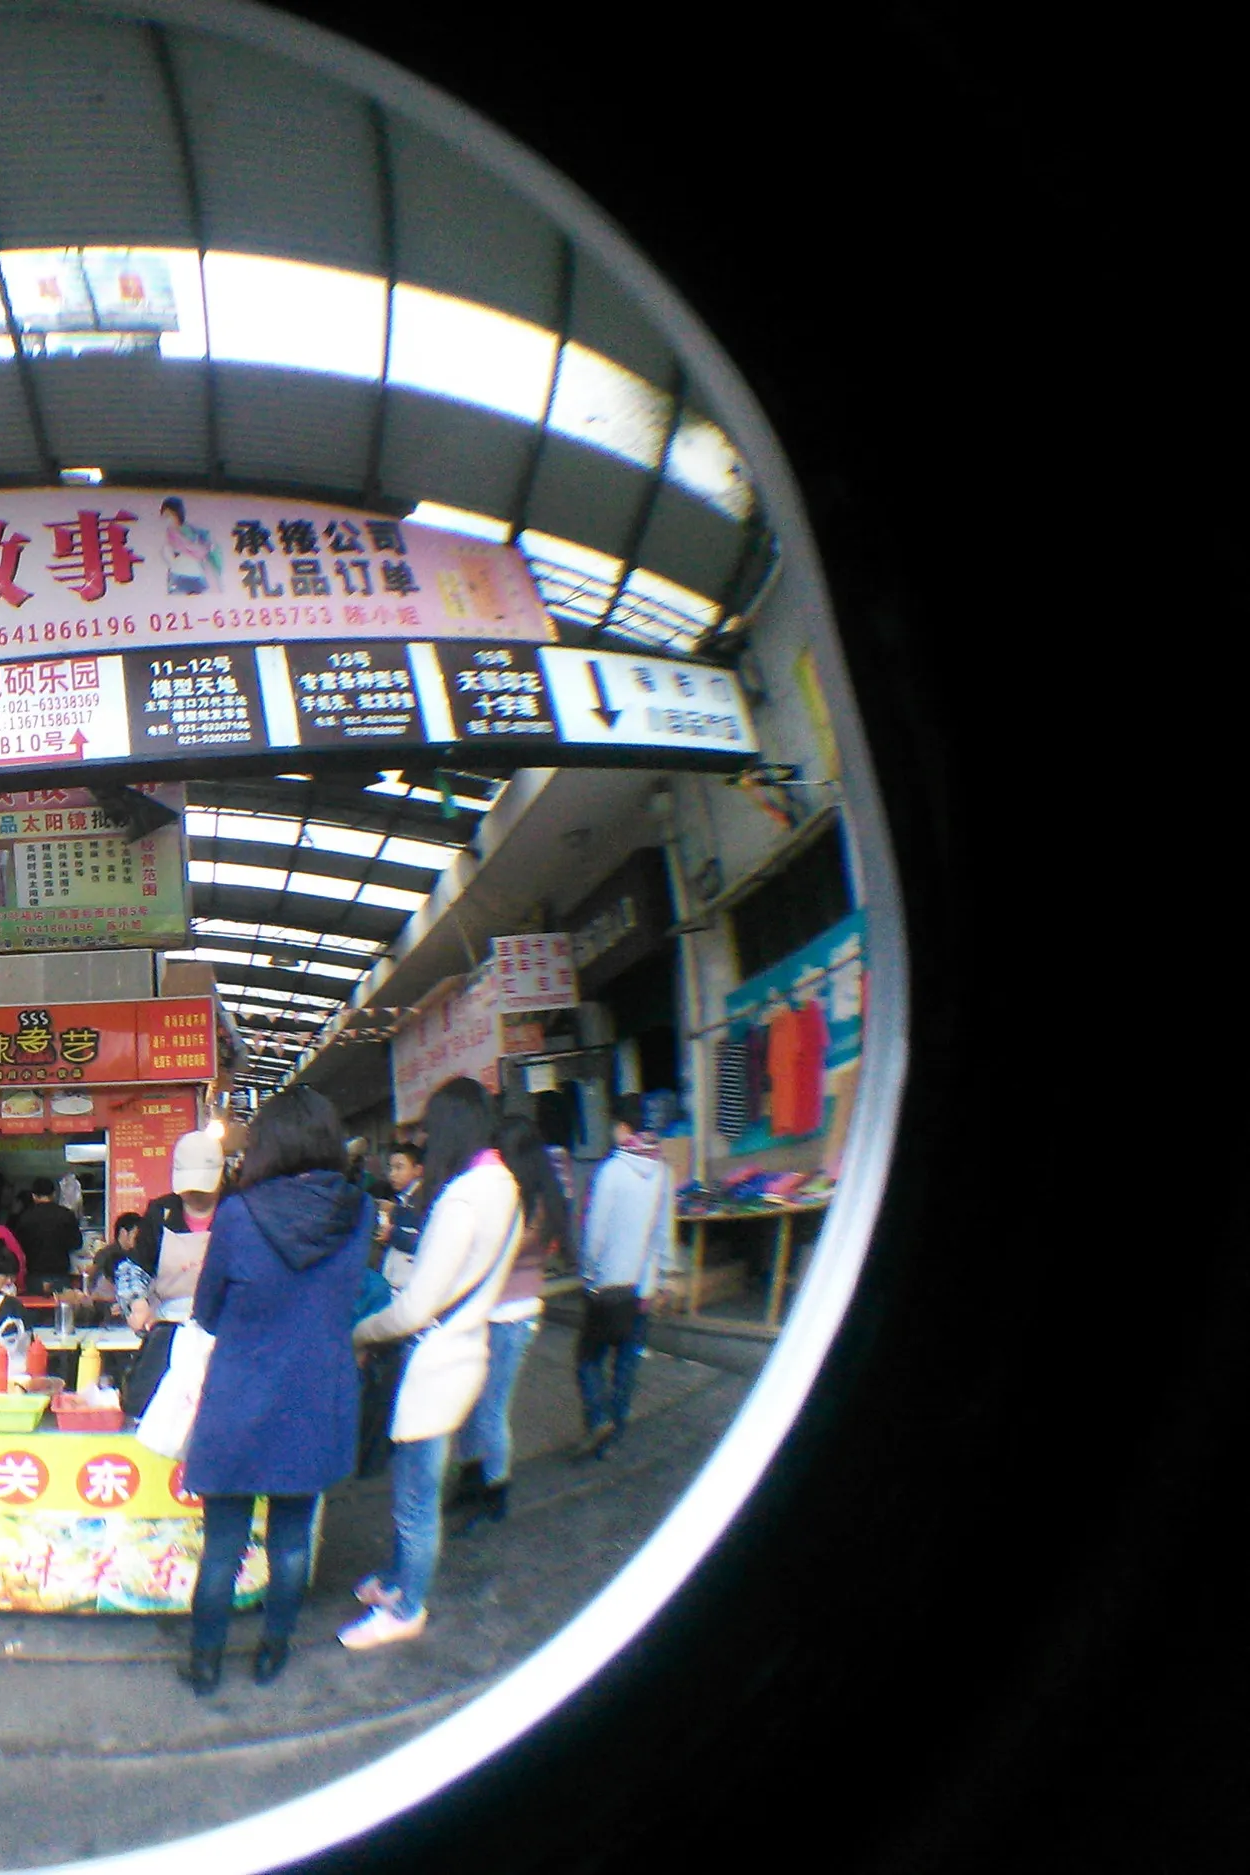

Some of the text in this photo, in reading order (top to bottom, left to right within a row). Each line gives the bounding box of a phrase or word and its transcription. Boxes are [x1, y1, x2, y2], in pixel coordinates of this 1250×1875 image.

[231, 517, 411, 556] 承接公司
[238, 558, 421, 600] 礼品订单
[150, 606, 333, 632] 021-63285753
[150, 655, 232, 676] 11-12号
[150, 675, 238, 699] 模型天地
